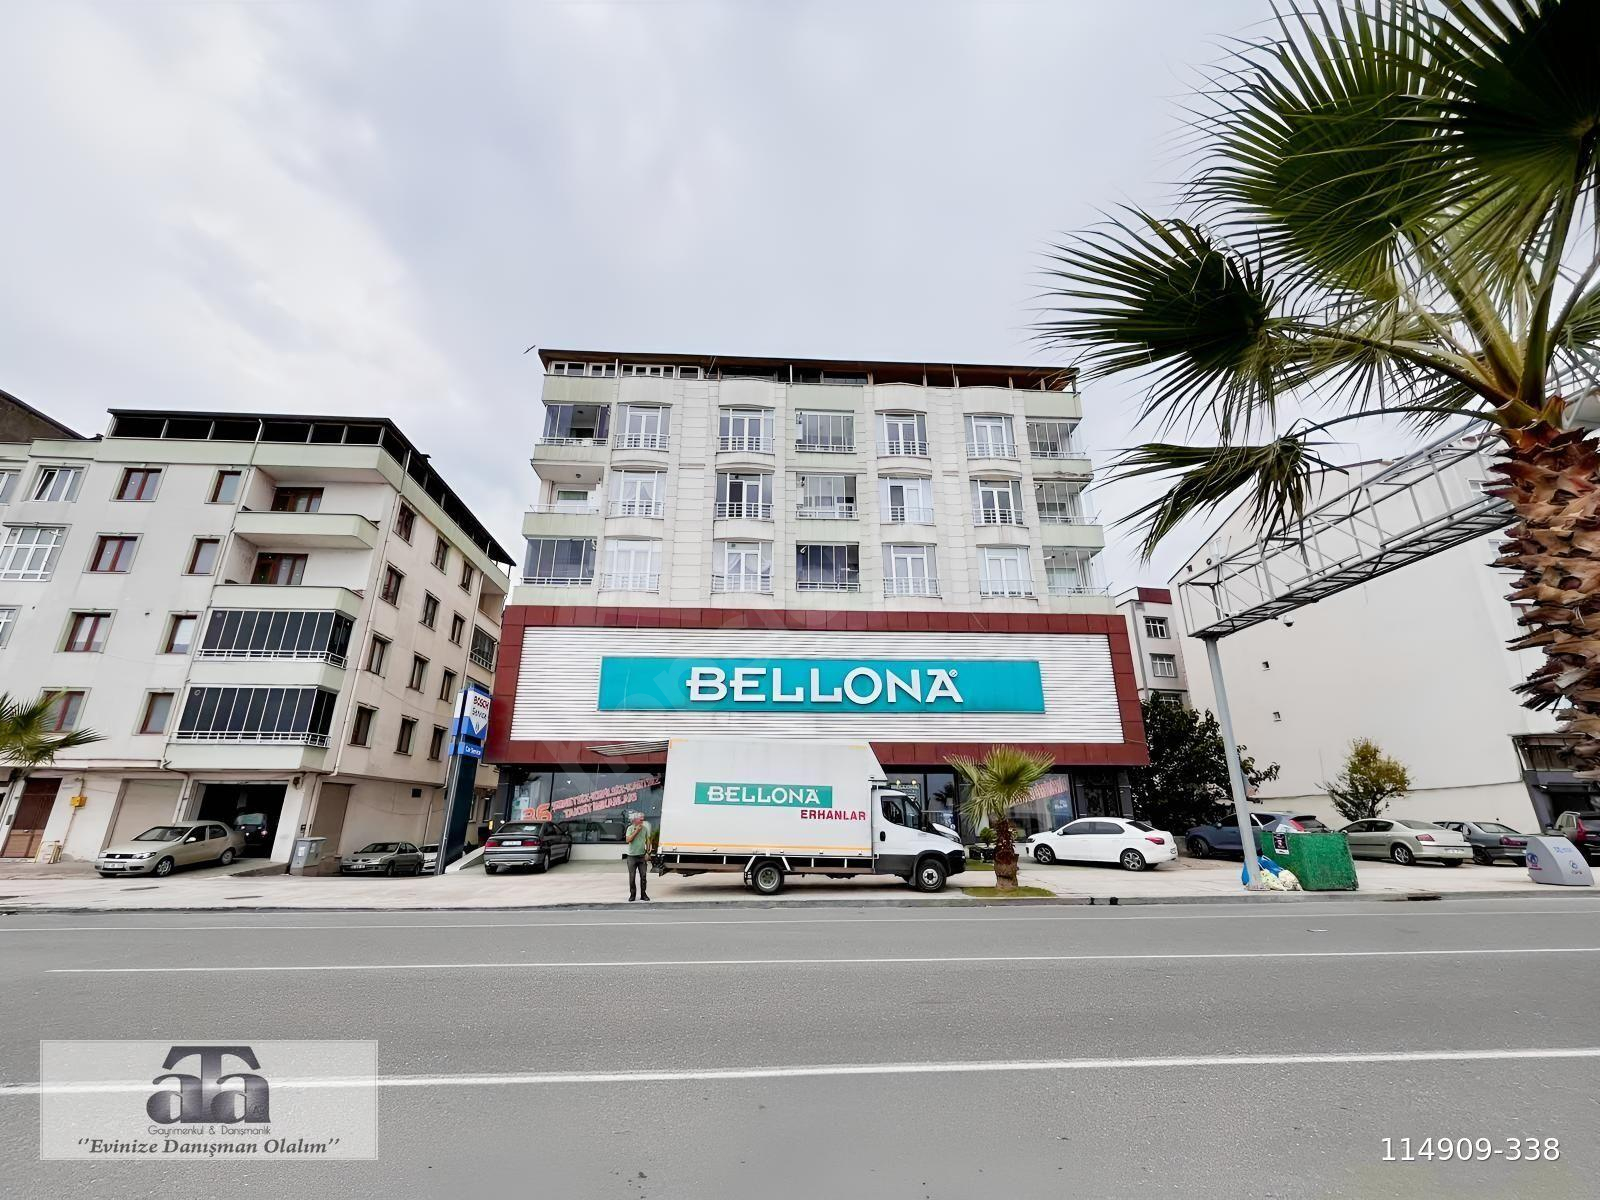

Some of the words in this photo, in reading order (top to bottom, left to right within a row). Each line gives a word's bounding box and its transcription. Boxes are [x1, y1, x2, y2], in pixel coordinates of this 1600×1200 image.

[686, 667, 963, 705] BELLONA
[707, 785, 820, 805] BELLONA
[800, 809, 867, 821] ERHANLAR
